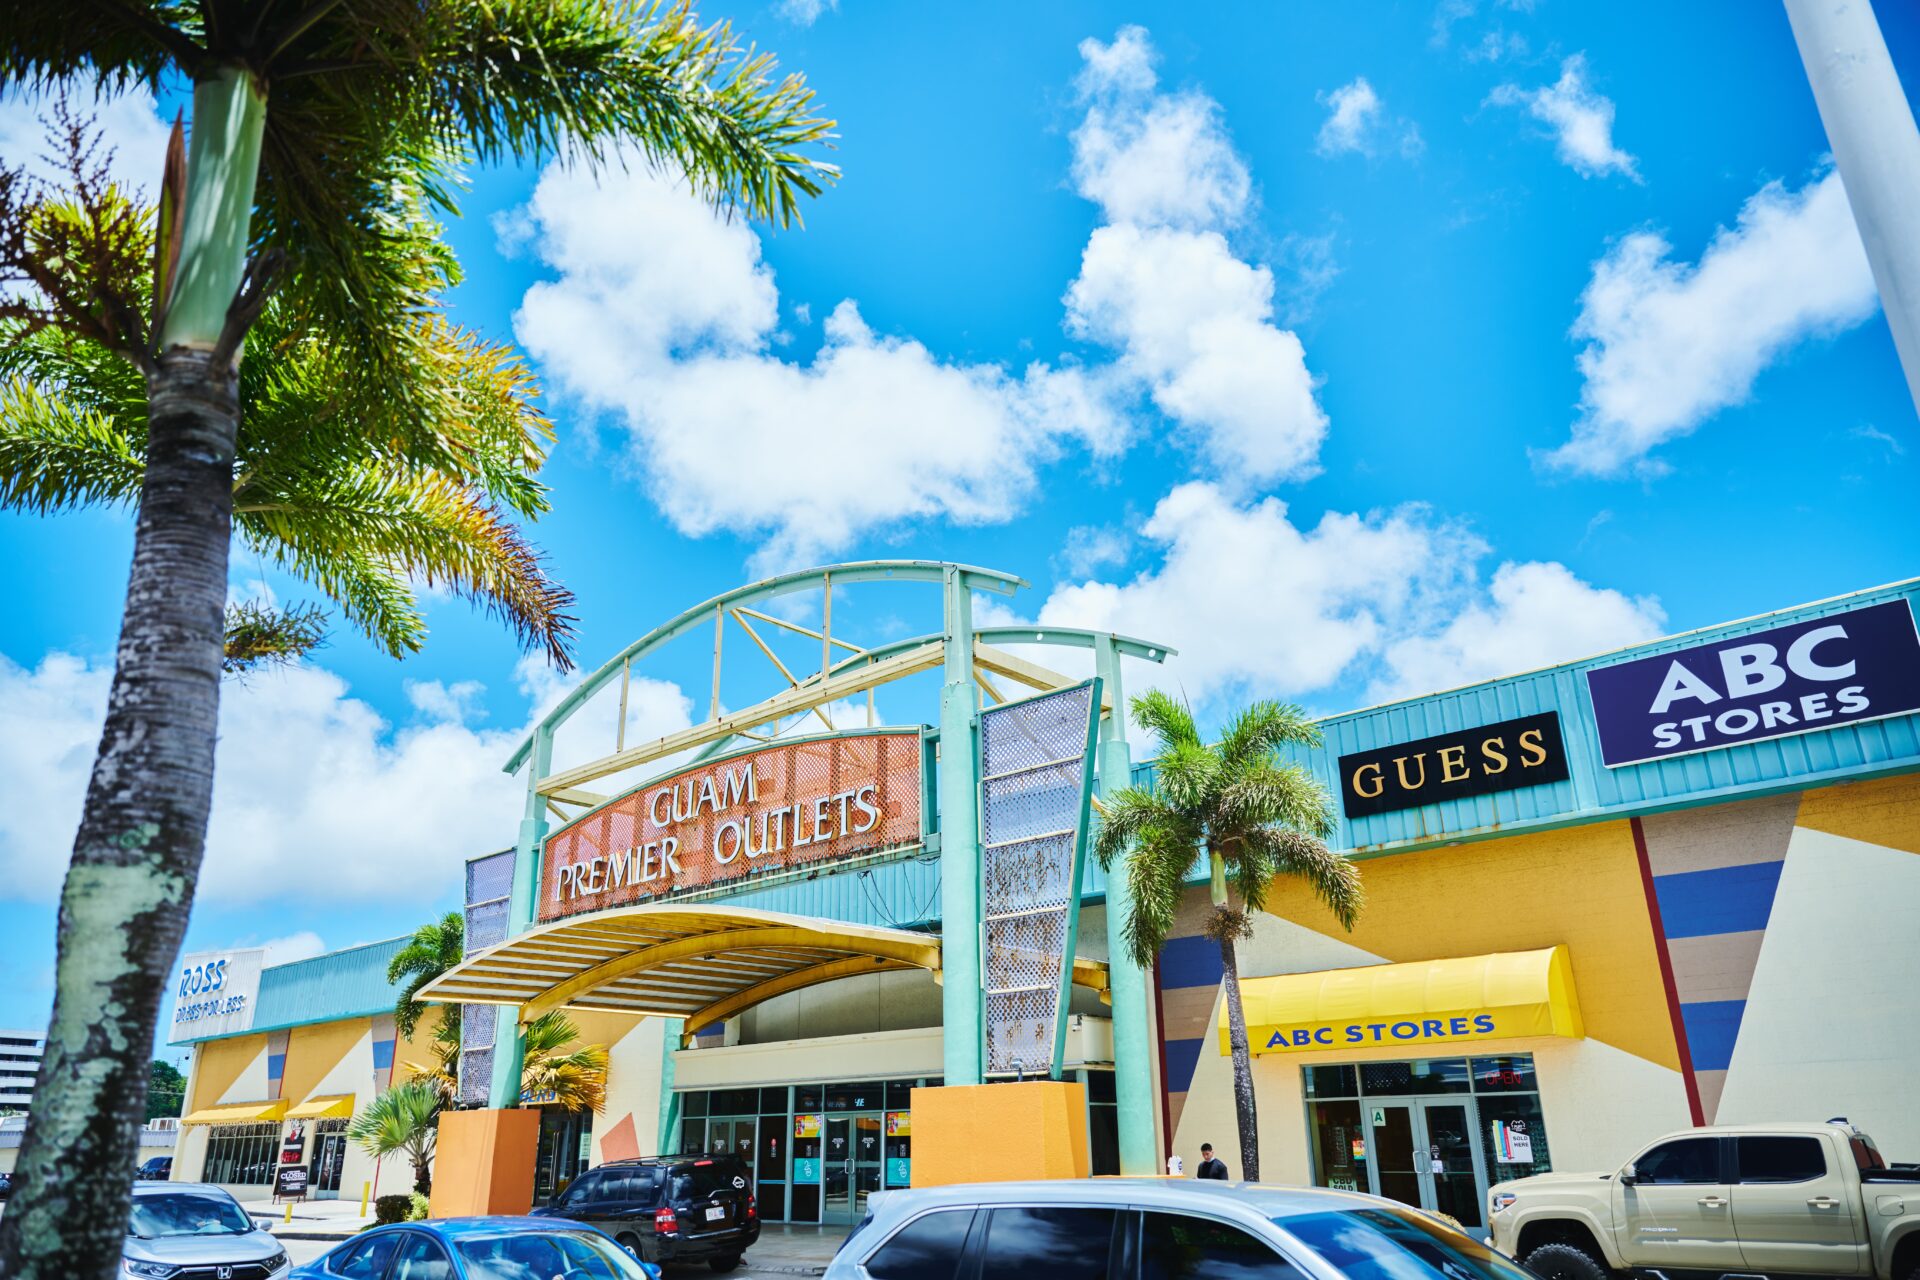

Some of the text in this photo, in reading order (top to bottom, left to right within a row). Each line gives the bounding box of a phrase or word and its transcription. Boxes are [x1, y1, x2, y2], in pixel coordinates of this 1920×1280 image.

[1648, 624, 1857, 714] ABC
[1651, 685, 1871, 749] STORES
[1352, 728, 1548, 798] GUESS
[650, 763, 760, 828] GUAM
[556, 784, 882, 901] PREMIER OUTLETS
[179, 959, 226, 998] ROSS
[1266, 1014, 1495, 1048] ABC STORES
[1485, 1071, 1522, 1086] OPEN
[1374, 1111, 1383, 1122] A
[280, 1171, 307, 1180] CLOSED
[1333, 1175, 1352, 1185] CBD
